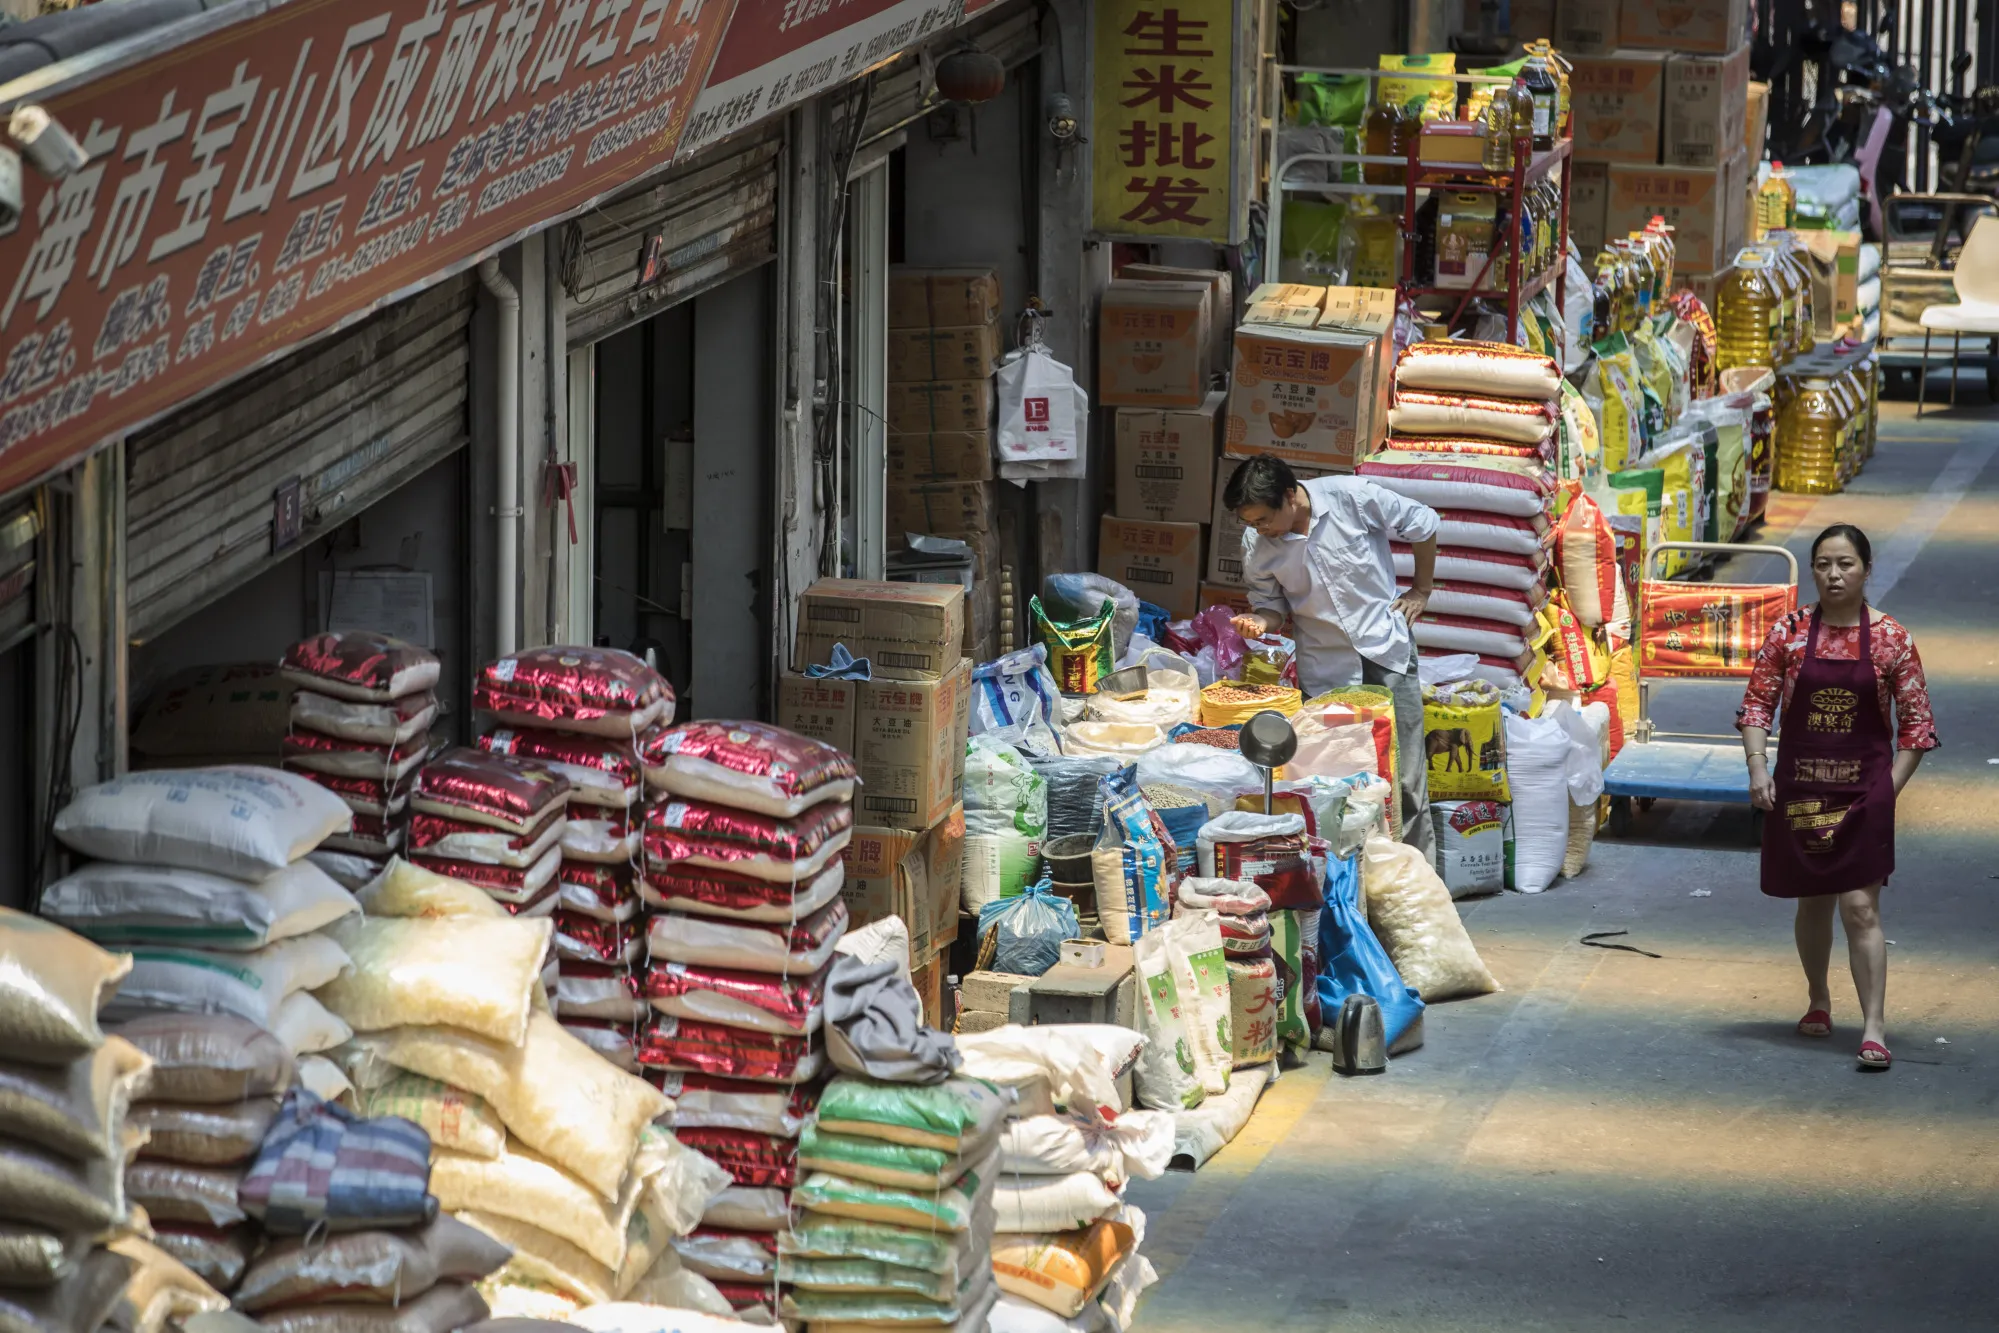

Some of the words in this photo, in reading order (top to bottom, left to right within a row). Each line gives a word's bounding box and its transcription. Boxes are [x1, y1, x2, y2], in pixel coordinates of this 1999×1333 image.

[1119, 9, 1216, 226] 生米批发
[1264, 346, 1331, 371] 元宝牌
[1273, 382, 1317, 397] 大豆油
[1029, 401, 1045, 419] E
[878, 690, 923, 707] 元宝牌
[873, 716, 912, 729] 大豆油
